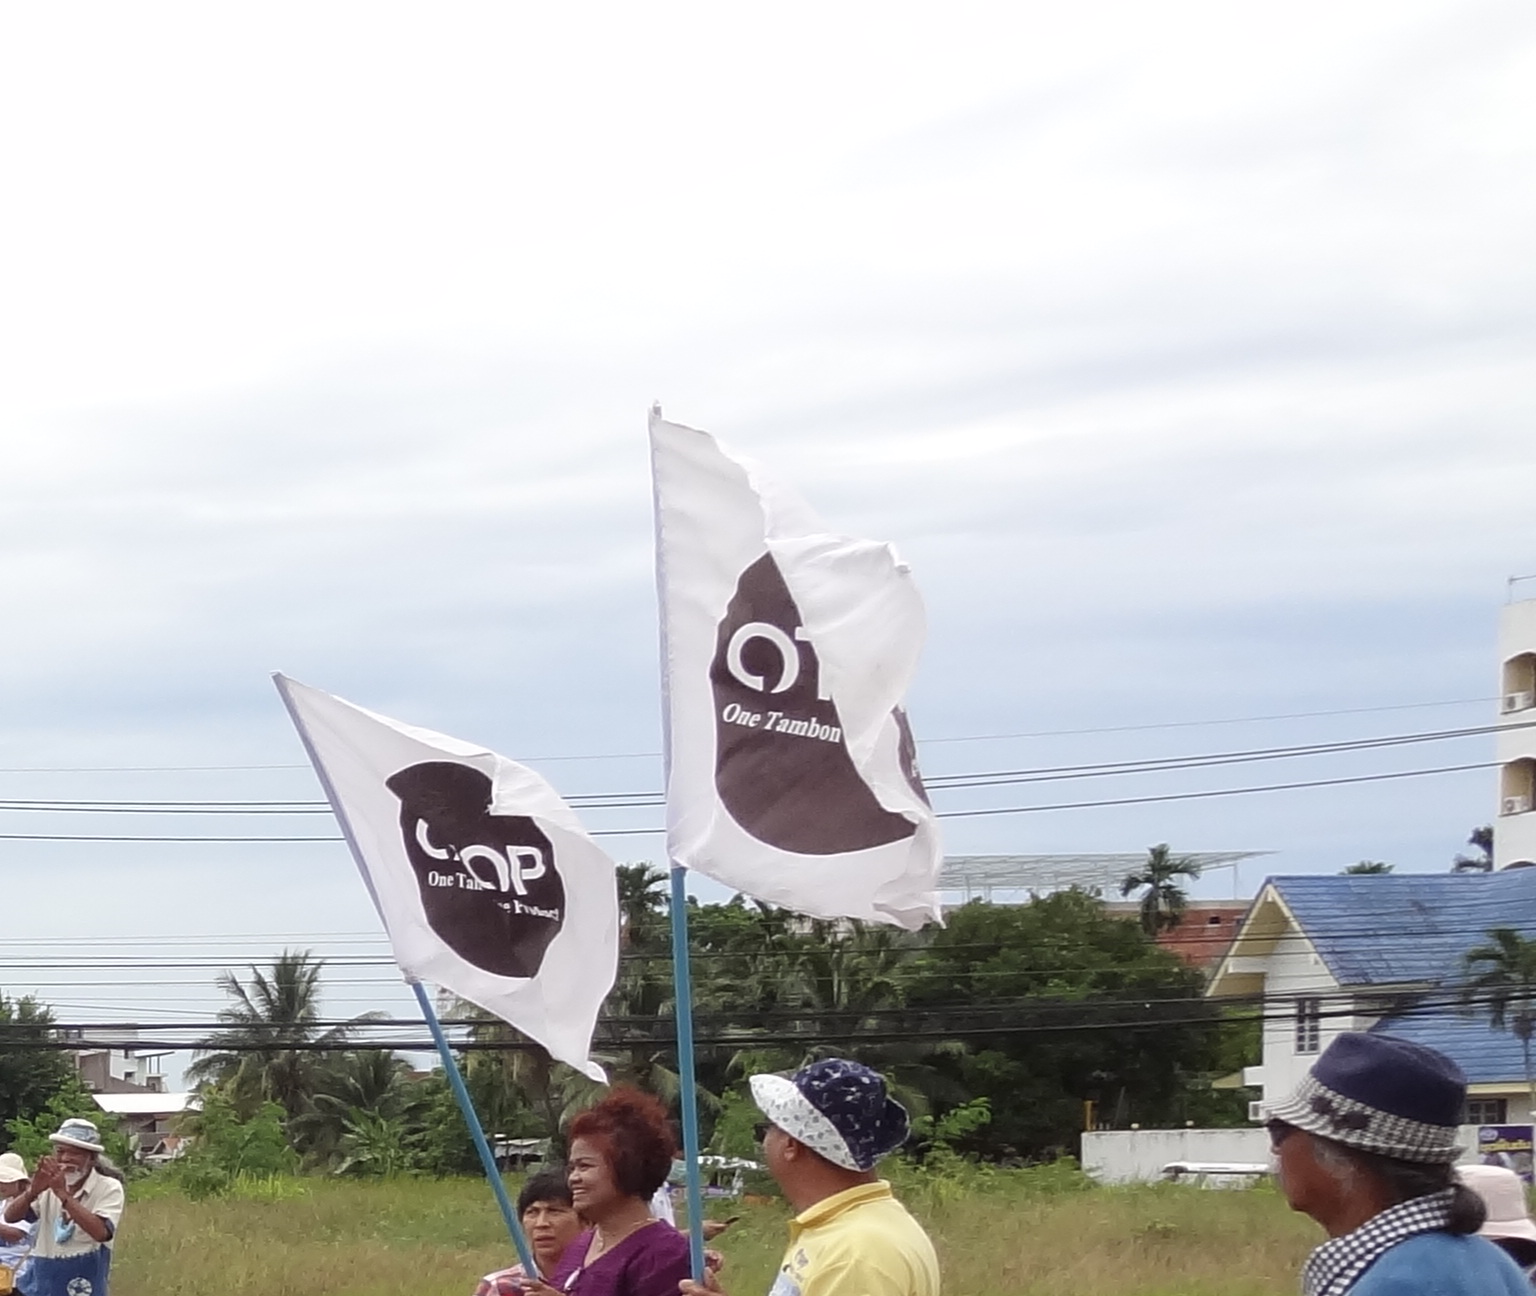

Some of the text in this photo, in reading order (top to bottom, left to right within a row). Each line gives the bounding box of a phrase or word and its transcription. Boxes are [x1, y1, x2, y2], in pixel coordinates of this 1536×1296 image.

[722, 702, 843, 743] One Tambon
[428, 871, 454, 886] One
